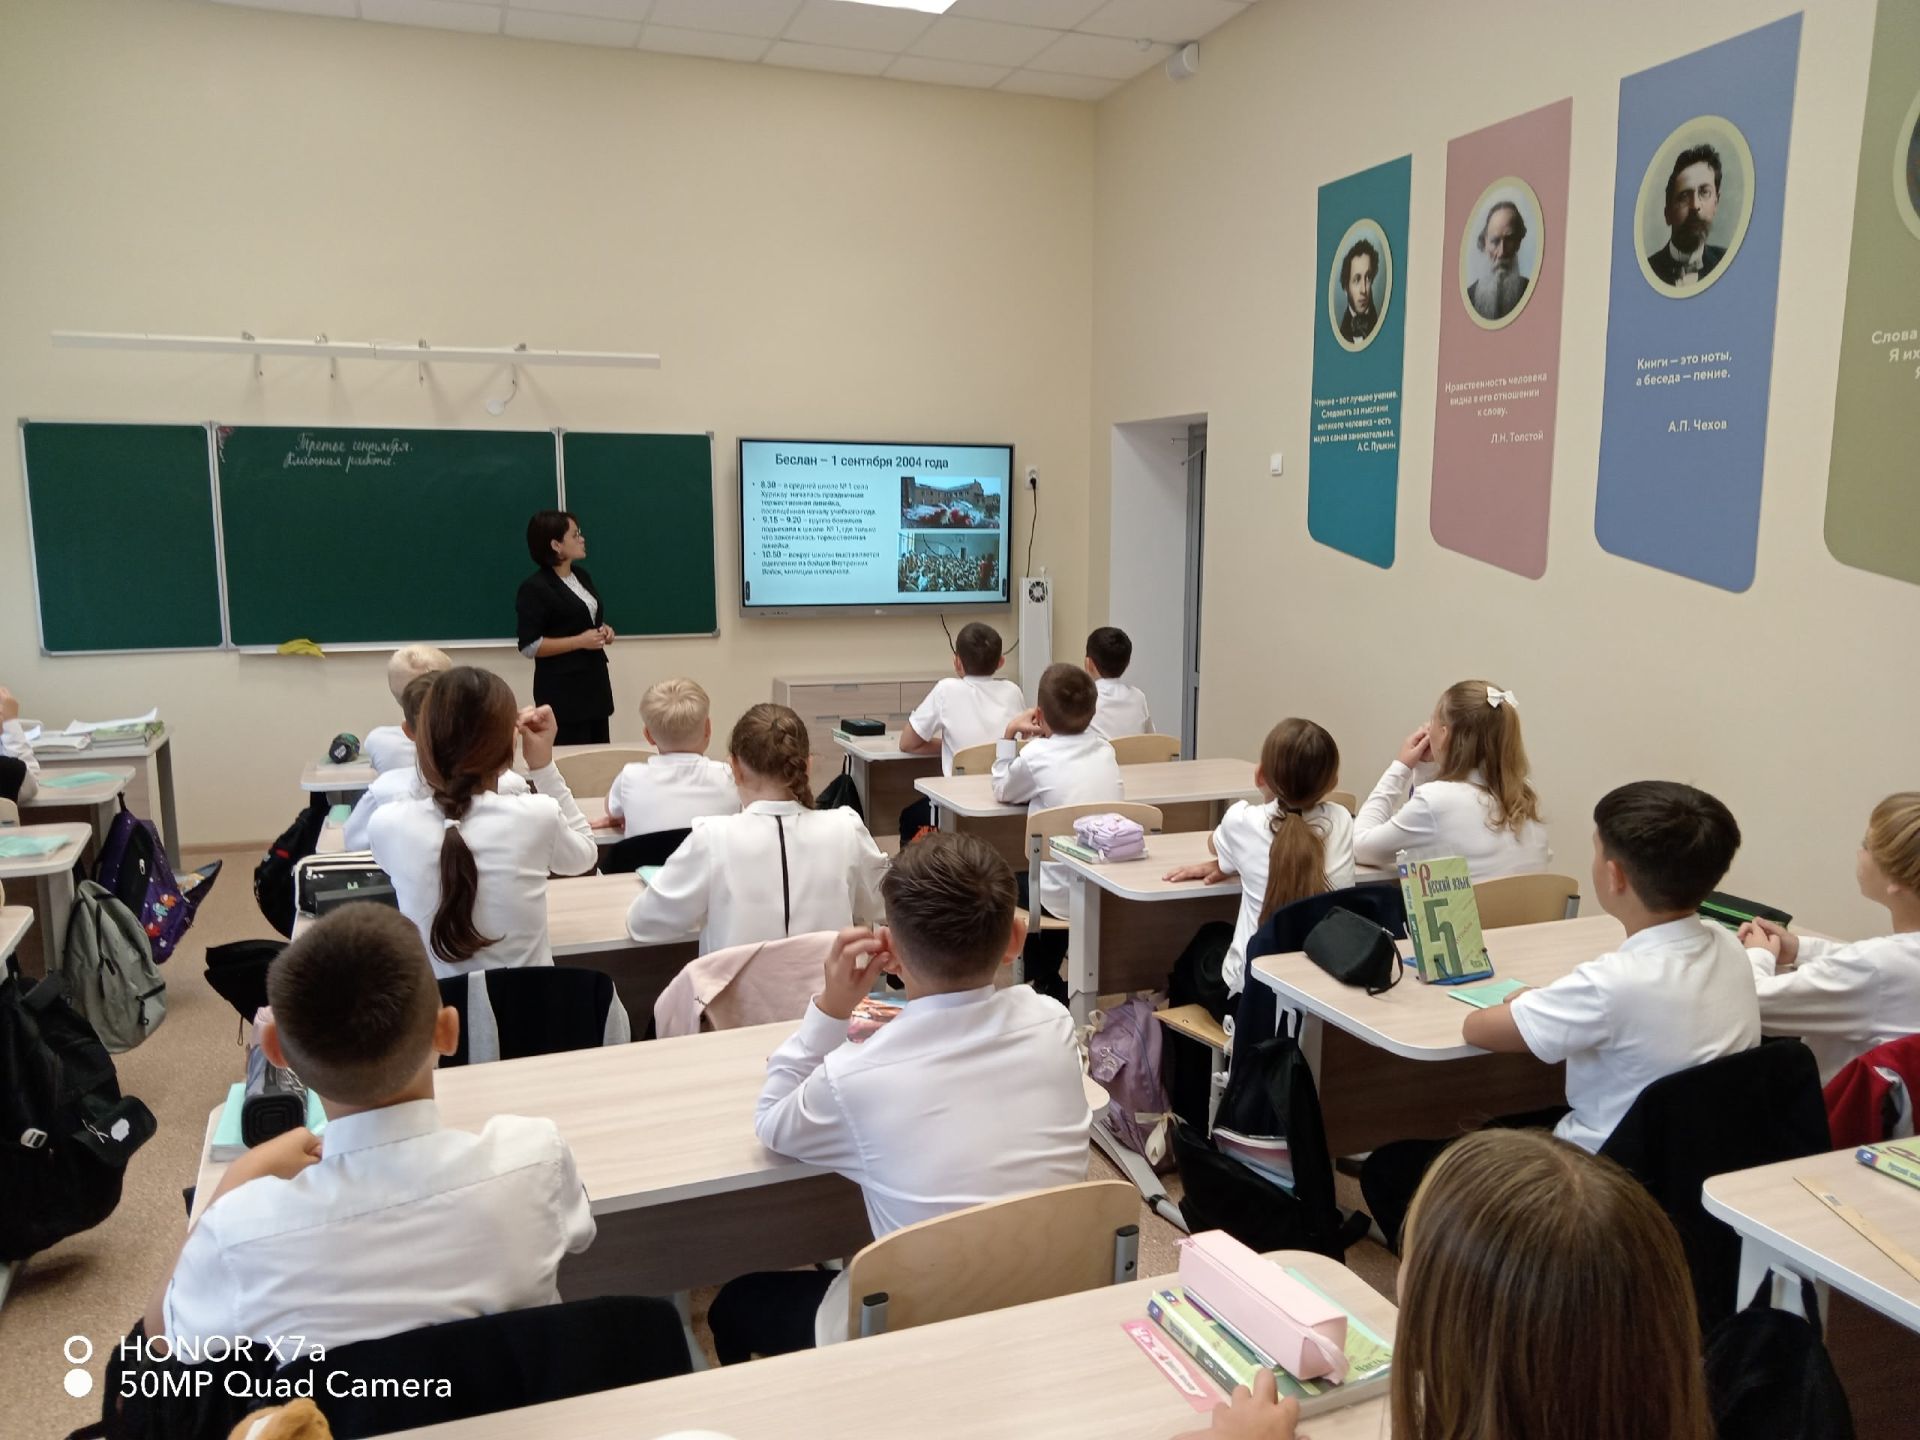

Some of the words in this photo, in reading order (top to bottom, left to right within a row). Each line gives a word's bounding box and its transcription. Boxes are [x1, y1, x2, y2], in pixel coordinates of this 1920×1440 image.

[1871, 329, 1918, 344] Слова
[1637, 358, 1668, 370] Книги
[1680, 355, 1699, 365] это
[1701, 351, 1732, 364] ноты,
[1889, 348, 1900, 363] Я
[1445, 378, 1507, 393] Нравственность
[1508, 372, 1547, 385] человека
[1636, 377, 1642, 386] а
[1644, 373, 1681, 386] беседа
[1693, 369, 1731, 381] пение.
[1450, 396, 1472, 406] видна
[1479, 394, 1493, 403] его
[1493, 389, 1540, 401] отношении
[1321, 409, 1352, 419] Следовать
[1477, 409, 1482, 417] к
[1483, 407, 1508, 417] слову.
[1344, 419, 1373, 428] человека
[1377, 417, 1392, 426] есть
[1668, 420, 1690, 433] А.П.
[1693, 419, 1727, 431] Чехов
[1510, 430, 1544, 442] Толстой
[1370, 441, 1396, 453] Пушкин
[775, 453, 818, 466] Беслан
[831, 455, 837, 466] 1
[840, 455, 893, 469] сентября
[896, 456, 921, 467] 2004
[925, 458, 949, 470] года
[1419, 863, 1452, 898] Русский
[1452, 875, 1471, 892] язык
[1423, 898, 1464, 978] 5
